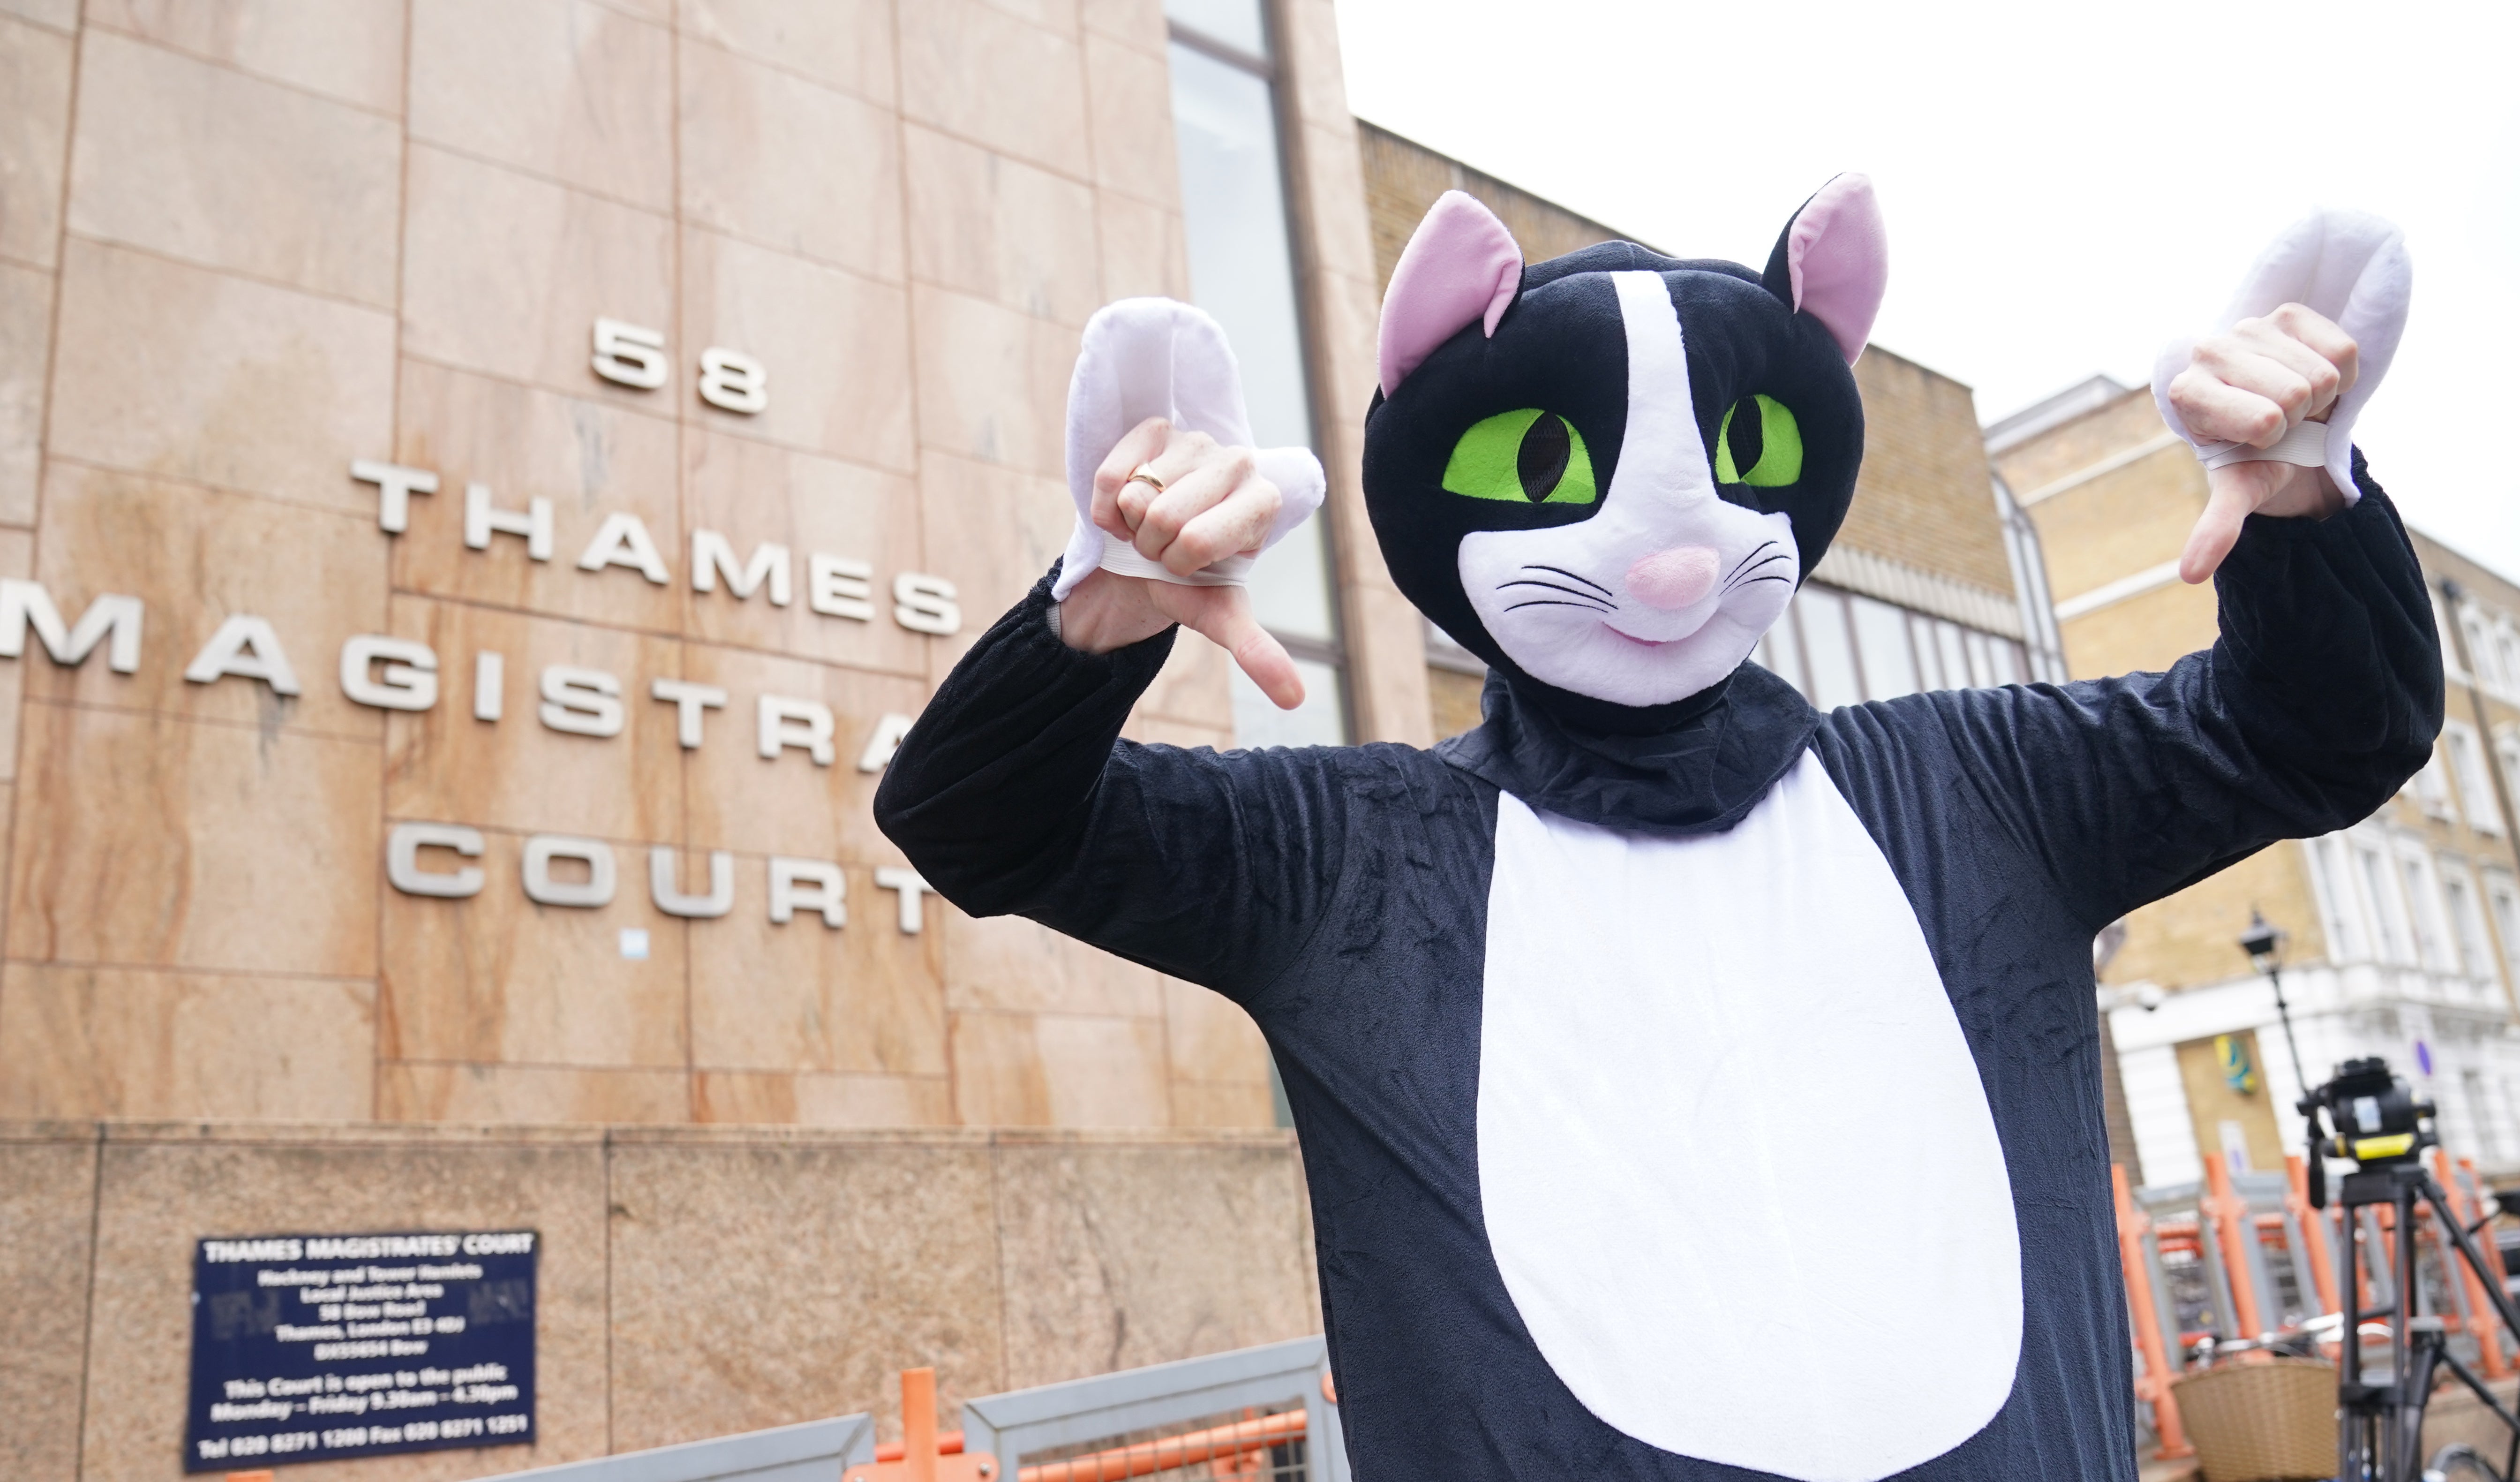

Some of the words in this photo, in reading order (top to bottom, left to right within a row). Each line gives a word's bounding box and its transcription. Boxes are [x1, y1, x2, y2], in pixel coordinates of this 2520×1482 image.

[592, 316, 768, 415] 58
[351, 461, 962, 636] THAMES
[387, 823, 938, 935] COURT
[203, 1239, 303, 1263] THAMES
[306, 1235, 461, 1260] MAGISTRATES'
[462, 1233, 534, 1255] COURT
[257, 1269, 330, 1288] Hackney
[331, 1265, 366, 1284] and
[367, 1265, 416, 1283] Tower
[417, 1262, 483, 1281] Hamlets
[300, 1284, 347, 1304] Local
[347, 1283, 404, 1302] Justice
[405, 1282, 444, 1299] Area
[318, 1303, 342, 1322] 58
[343, 1302, 381, 1320] Bow
[382, 1299, 427, 1318] Road
[274, 1323, 346, 1342] Thames,
[347, 1318, 410, 1338] London
[411, 1316, 434, 1335] E3
[389, 1338, 429, 1356] Bow
[223, 1378, 267, 1399] This
[267, 1375, 324, 1397] Court
[324, 1373, 344, 1393] is
[345, 1372, 394, 1394] open
[394, 1369, 418, 1388] to
[419, 1366, 451, 1386] the
[451, 1361, 508, 1387] public
[211, 1398, 293, 1422] Monday
[308, 1393, 369, 1415] Friday
[369, 1389, 438, 1410] 9.30am
[451, 1384, 519, 1405] 4.30pm
[197, 1437, 229, 1459] Tel
[230, 1435, 270, 1457] 020
[270, 1431, 318, 1453] 8271
[369, 1425, 403, 1444] Fax
[403, 1421, 439, 1442] 020
[439, 1417, 483, 1439] 8271
